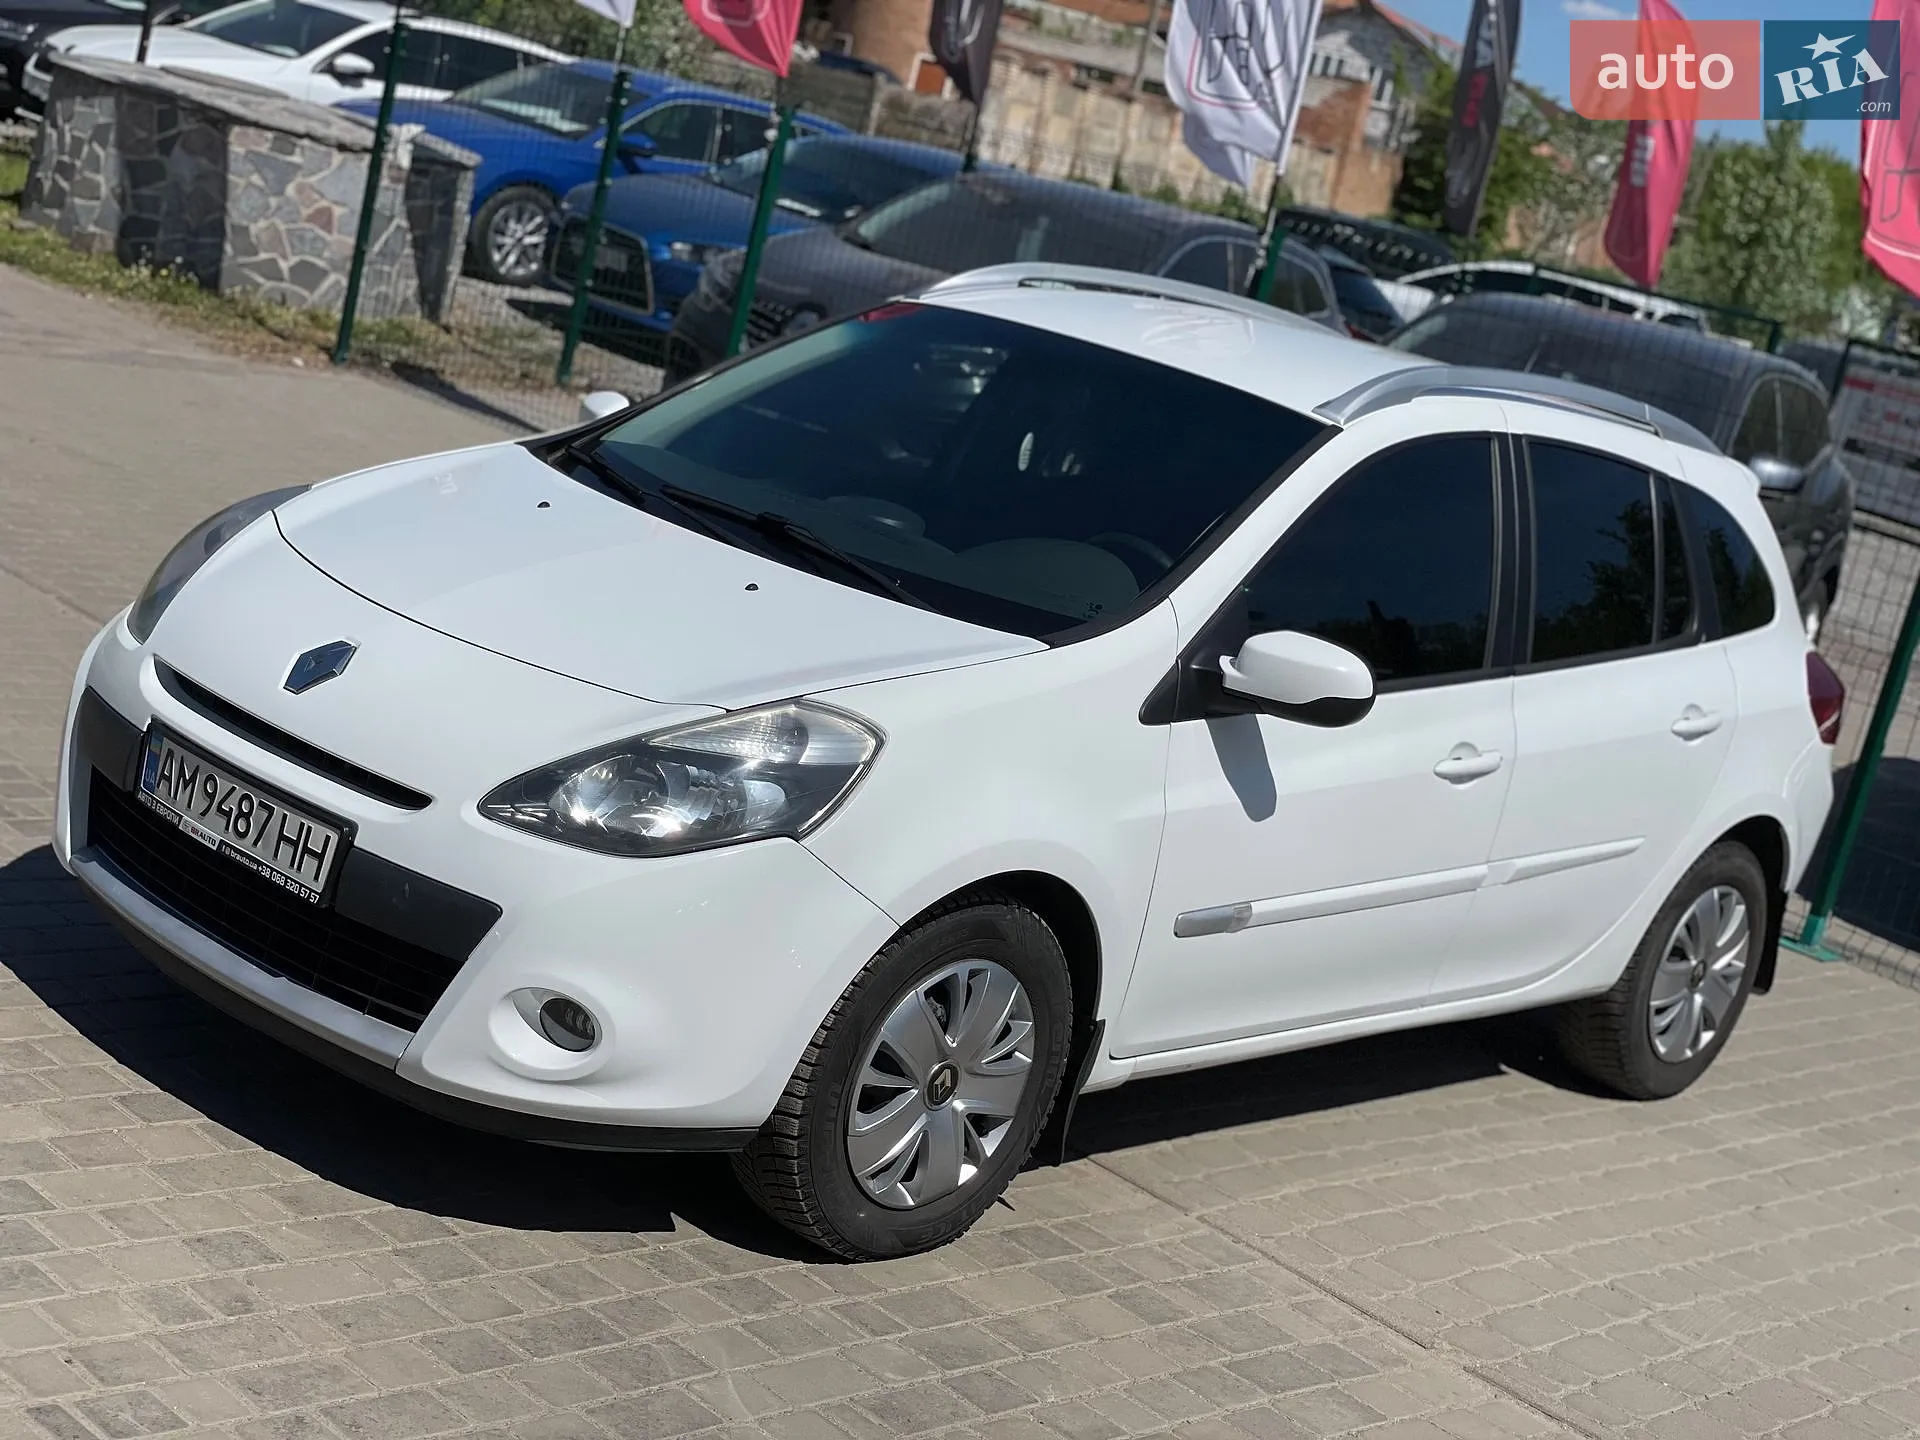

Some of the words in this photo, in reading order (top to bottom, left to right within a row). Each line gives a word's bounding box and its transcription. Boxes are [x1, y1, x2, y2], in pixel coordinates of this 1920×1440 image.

[199, 773, 276, 848] 9487
[271, 871, 286, 886] 068
[285, 879, 300, 894] 320
[300, 887, 310, 899] 57
[309, 892, 320, 904] 57
